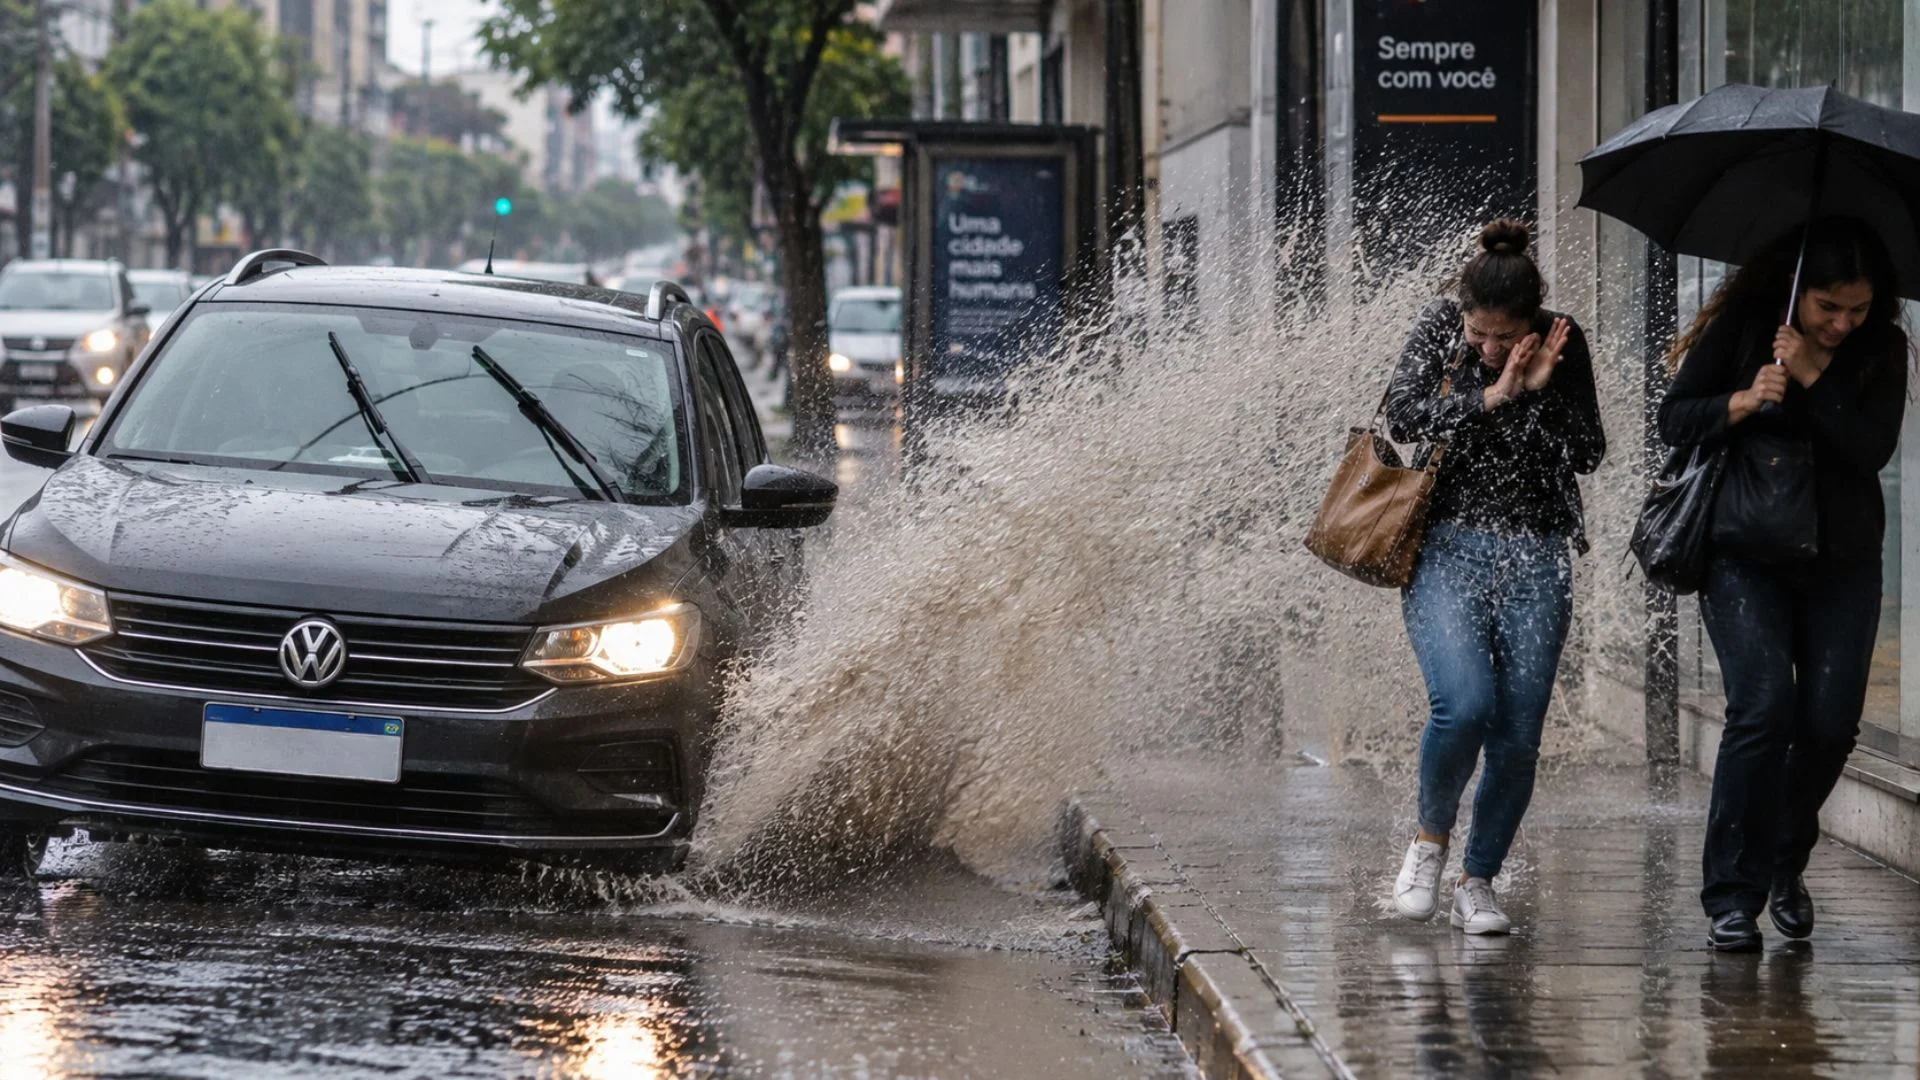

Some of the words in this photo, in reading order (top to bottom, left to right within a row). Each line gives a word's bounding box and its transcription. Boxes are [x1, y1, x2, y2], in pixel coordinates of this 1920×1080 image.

[1378, 35, 1475, 64] Sempre
[1378, 71, 1432, 89] com
[1438, 66, 1496, 89] você
[948, 212, 1001, 234] Uma
[948, 234, 1024, 257] cidade
[949, 258, 1002, 278] mais
